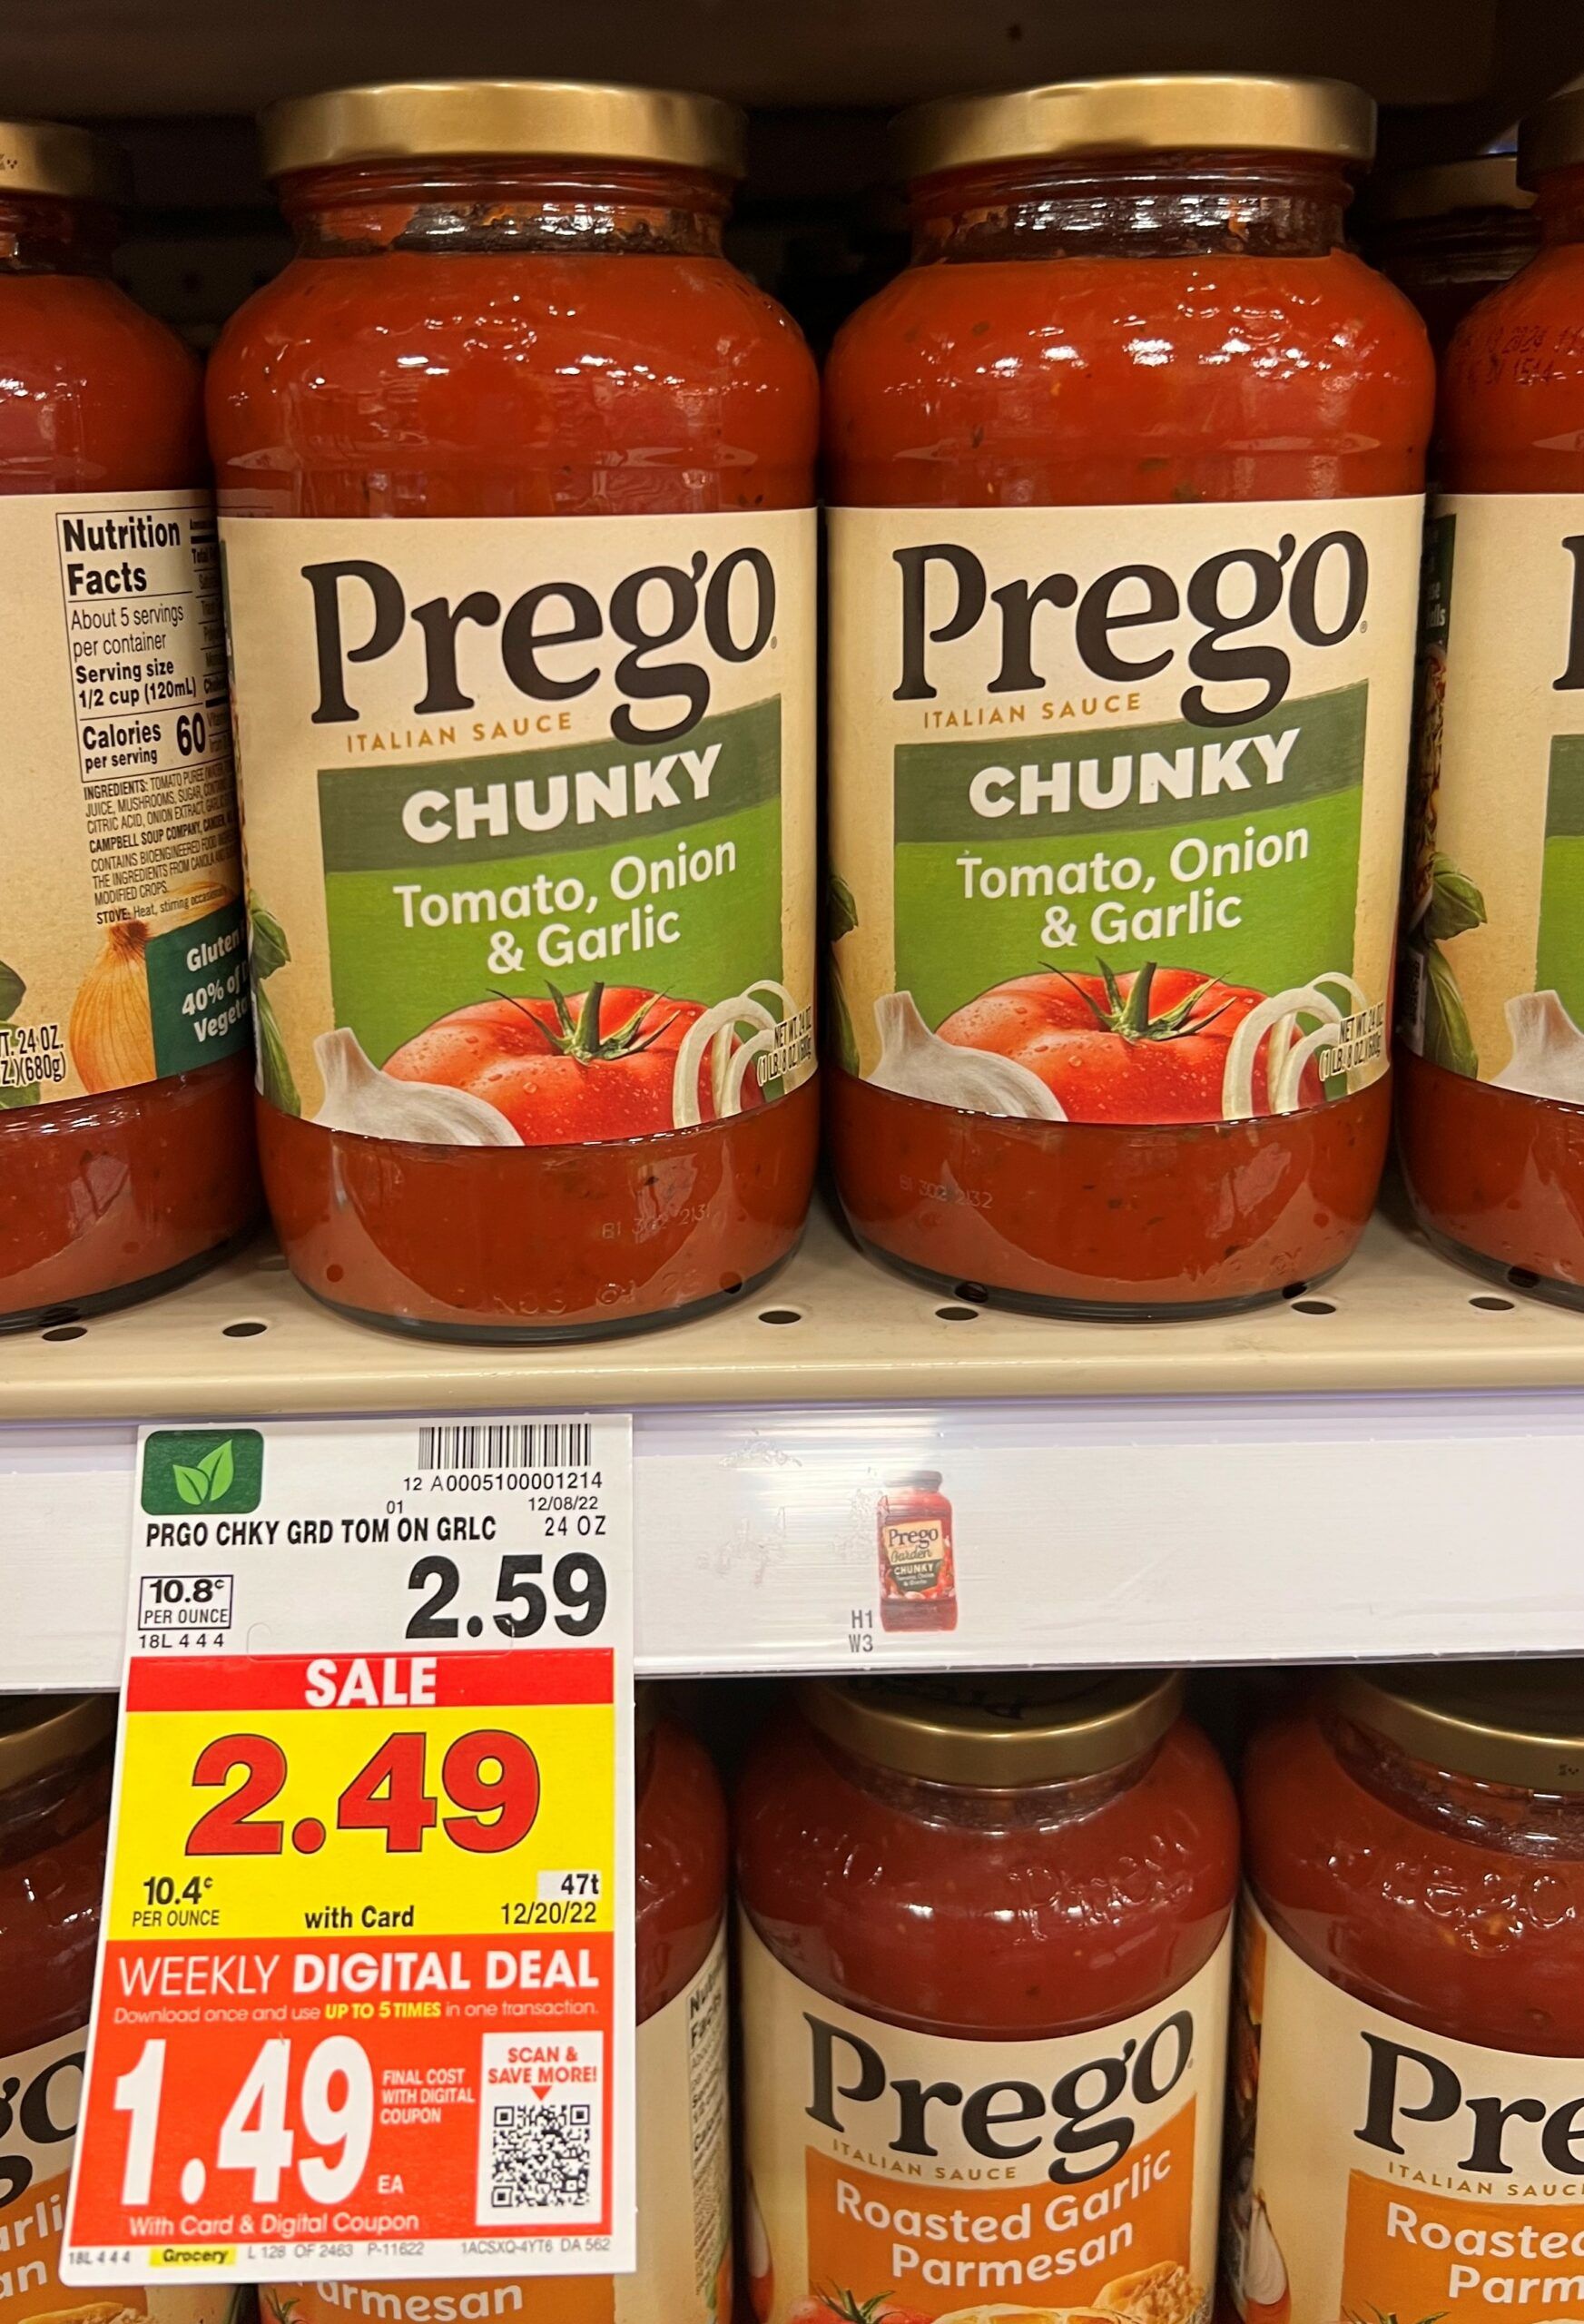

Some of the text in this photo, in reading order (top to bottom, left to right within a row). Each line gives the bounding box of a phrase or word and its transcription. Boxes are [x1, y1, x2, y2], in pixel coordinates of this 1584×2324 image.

[62, 515, 182, 552] Nutrition
[66, 561, 148, 596] Facts
[71, 608, 117, 630] About
[120, 606, 130, 627] 5
[133, 603, 184, 628] servings
[891, 529, 1370, 727] Prego
[73, 631, 167, 662] per container
[300, 547, 777, 746] Prego
[75, 659, 174, 684] Serving size
[78, 688, 104, 710] 1/2
[109, 688, 140, 707] cup
[144, 676, 197, 705] (120mL)
[923, 692, 1142, 730] ITALIAN SAUCE
[83, 720, 162, 751] Calories
[175, 711, 206, 756] 60
[347, 711, 574, 753] ITALIAN SAUCE
[84, 748, 158, 773] per serving
[969, 726, 1302, 819] CHUNKY
[84, 779, 149, 801] INGREDIENTS:
[150, 773, 182, 791] TOMATO
[400, 743, 723, 845] CHUNKY
[84, 802, 116, 817] JUICE,
[117, 792, 176, 813] MUSHROOMS,
[87, 817, 120, 834] CITRIC
[121, 813, 146, 829] ACID,
[146, 808, 173, 826] ONION
[89, 833, 140, 854] CAMPBELL
[141, 828, 164, 846] SOUP
[165, 821, 202, 840] COMPANY,
[91, 853, 138, 873] CONTAINS
[140, 841, 200, 864] BIOENGINEERED
[956, 826, 1310, 899] Tomato, Onion
[93, 873, 111, 890] THE
[112, 863, 169, 885] INGREDIENTS
[169, 857, 191, 874] FROM
[392, 839, 737, 929] Tomato, Onion
[93, 886, 137, 906] MODIFIED
[139, 881, 169, 899] CROPS.
[96, 908, 132, 925] STOVE:
[133, 903, 158, 918] Heat,
[160, 896, 190, 914] stirring
[1039, 886, 1243, 949] & Garlic
[186, 928, 241, 972] Gluten
[486, 904, 682, 976] & Garlic
[182, 979, 224, 1016] 40%
[226, 964, 241, 995] of
[17, 1029, 36, 1055] 24
[40, 1024, 64, 1051] OZ.
[403, 1471, 603, 1492] 12 A0005100001214
[386, 1500, 404, 1514] 01
[527, 1495, 599, 1512] 12/08/22
[145, 1514, 607, 1548] PRGO CHKY GRD TOM ON GRLC 24 OZ
[889, 1528, 940, 1550] Prego
[893, 1563, 934, 1576] CHUNKY
[404, 1551, 608, 1640] 2.59
[143, 1608, 228, 1625] PER OUNCE
[851, 1609, 874, 1630] H1
[138, 1632, 225, 1649] 18L 4 4 4
[848, 1633, 874, 1654] W3
[304, 1657, 438, 1708] SALE
[183, 1728, 541, 1857] 2.49
[560, 1873, 600, 1896] 47t
[131, 1908, 221, 1927] PER OUNCE
[304, 1904, 415, 1929] with Card
[500, 1900, 597, 1925] 12/20/22
[118, 1948, 600, 1997] WEEKLY DIGITAL DEAL
[113, 1999, 600, 2025] Download once and use UP TO 5 TIMES in one transaction.
[507, 2045, 578, 2063] SCAN &
[381, 2068, 466, 2086] FINAL COST
[487, 2065, 598, 2085] SAVE MORE!
[381, 2086, 476, 2104] WITH DIGITAL
[802, 2009, 1194, 2186] Prego
[113, 2034, 375, 2206] 1.49
[379, 2106, 442, 2125] COUPON
[831, 2138, 1018, 2181] ITALIAN SAUCE
[377, 2174, 404, 2194] EA
[1388, 2161, 1584, 2198] ITALIAN SAUC
[834, 2148, 1172, 2244] Roasted Garlic
[128, 2211, 419, 2240] With Card & Digital Coupon
[68, 2250, 131, 2266] 18L 4 4 4
[162, 2248, 228, 2265] Grocery
[247, 2241, 425, 2260] L 128 OF 2463 P-11622
[560, 2238, 583, 2253] DA
[585, 2237, 611, 2252] 562
[890, 2221, 1135, 2289] Parmesan
[297, 2280, 524, 2323] armesan
